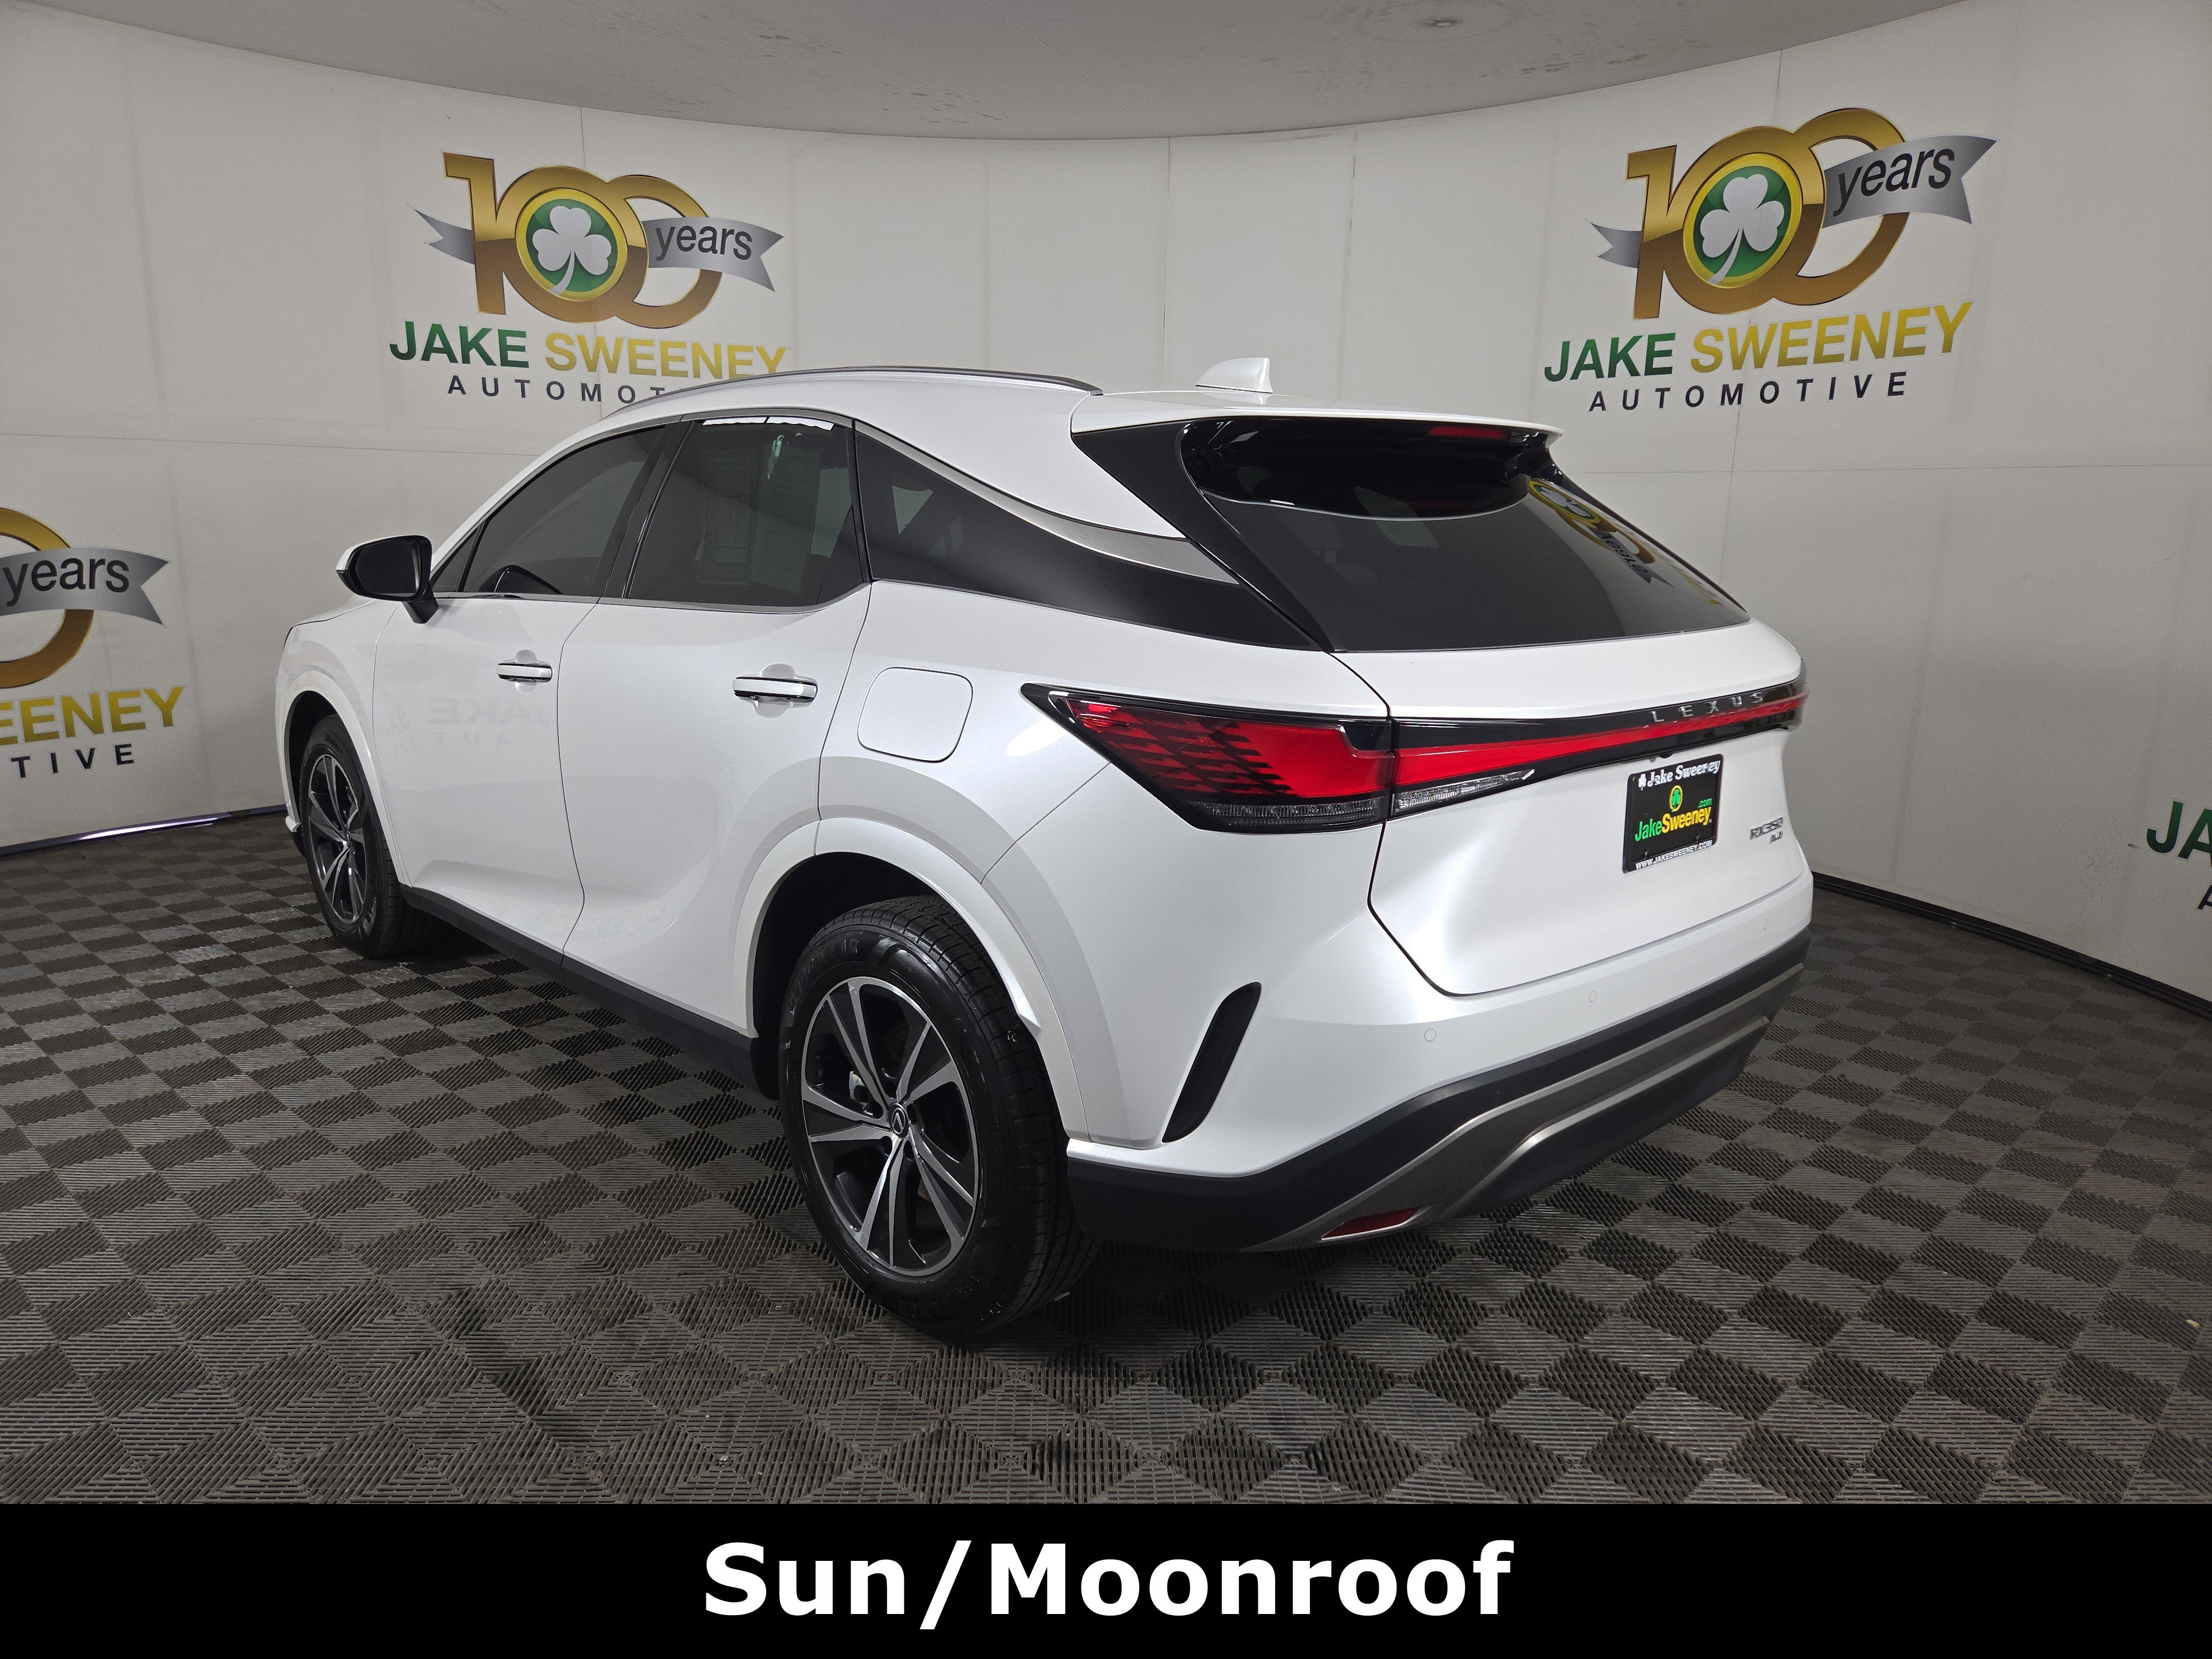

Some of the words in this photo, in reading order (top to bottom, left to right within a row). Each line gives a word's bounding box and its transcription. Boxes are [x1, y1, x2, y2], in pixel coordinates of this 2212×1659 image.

[1833, 148, 1955, 217] years
[655, 224, 753, 261] years
[389, 320, 529, 368] JAKE
[545, 332, 788, 380] SWEENEY
[1544, 332, 1676, 382] JAKE
[1690, 301, 1973, 374] SWEENEY
[1589, 371, 1907, 413] AUTOMOTIVE
[2, 557, 130, 607] years
[1649, 691, 1764, 723] LEXUS
[1647, 769, 1673, 787] Jake
[1675, 760, 1721, 780] Sweeney
[1635, 806, 1712, 841] JakeSweeney
[1635, 840, 1713, 870] WWW.JAKESWEENEY.COM
